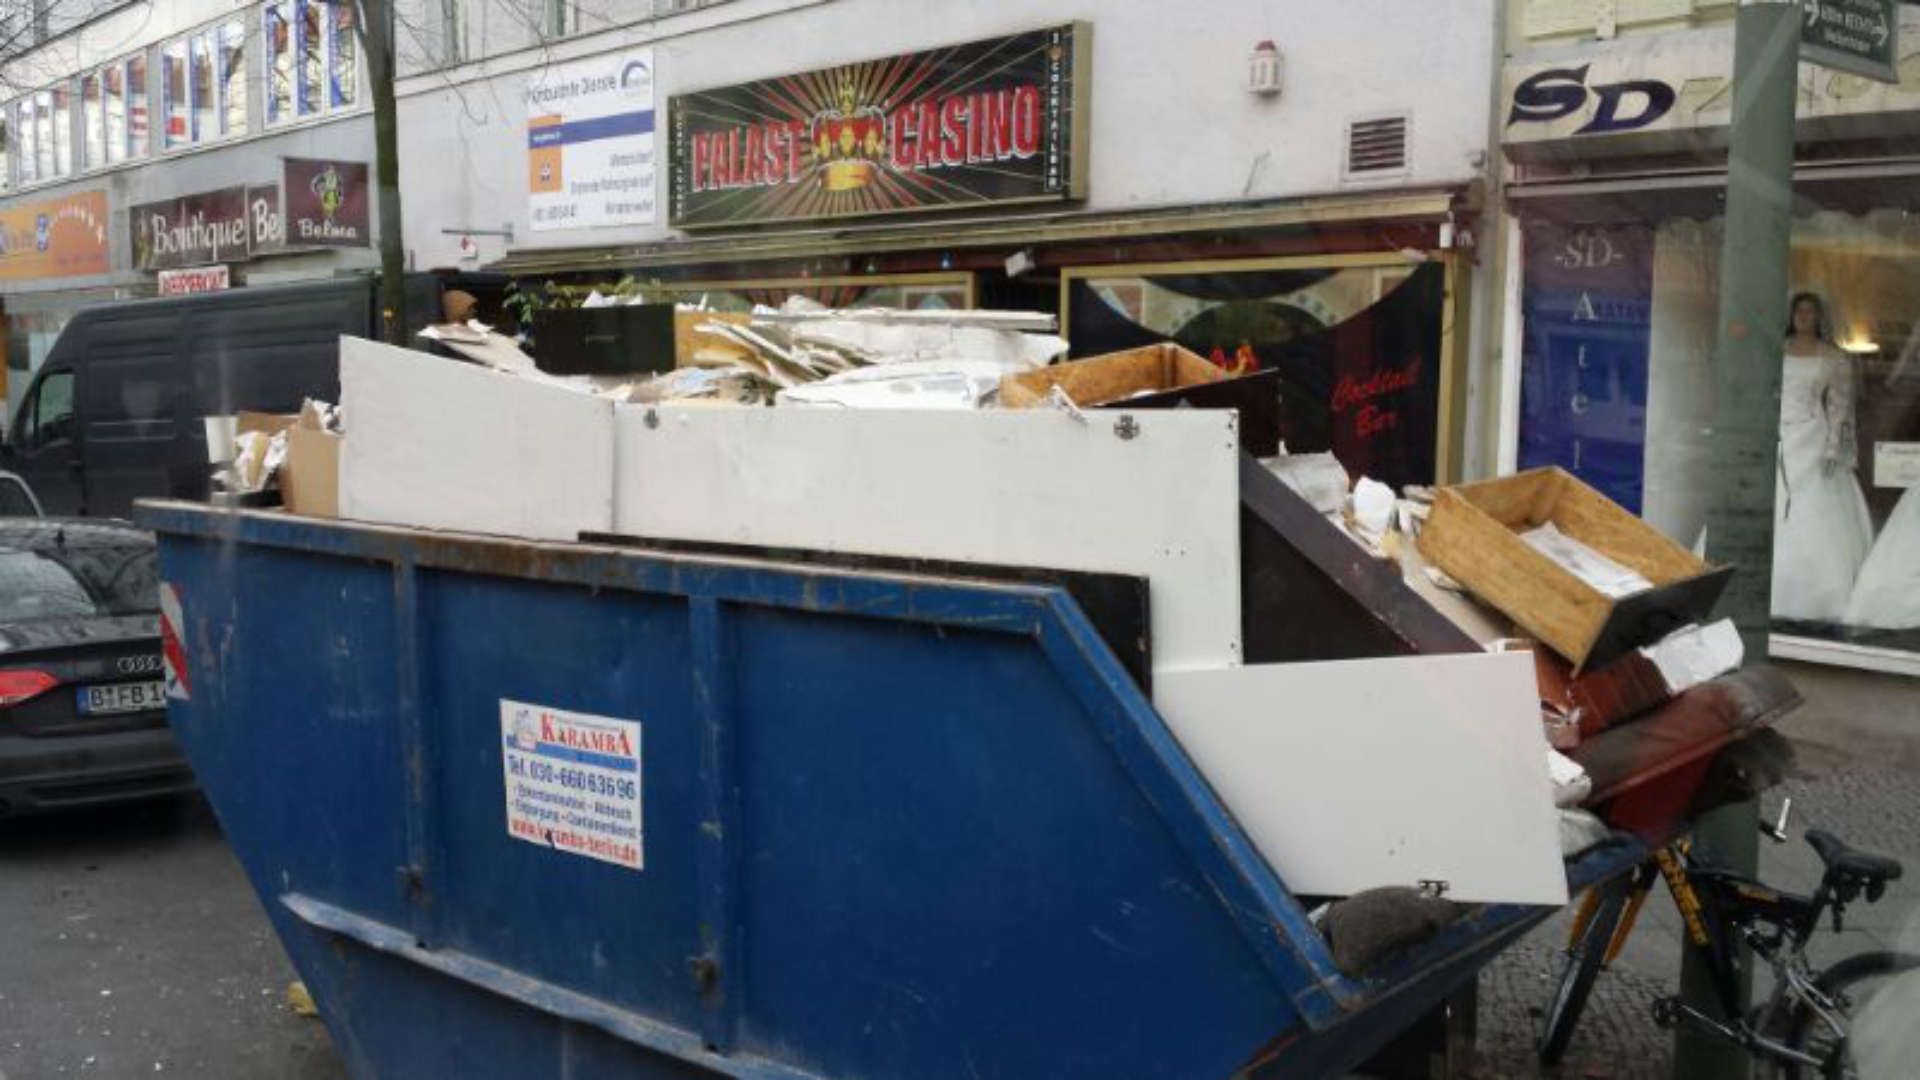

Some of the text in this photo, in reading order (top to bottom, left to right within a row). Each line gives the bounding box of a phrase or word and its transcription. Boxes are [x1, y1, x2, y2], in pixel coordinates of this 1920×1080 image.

[1507, 63, 1676, 134] SD
[691, 117, 805, 193] PALAST
[888, 84, 1041, 172] CASINO
[152, 210, 244, 263] Boutique
